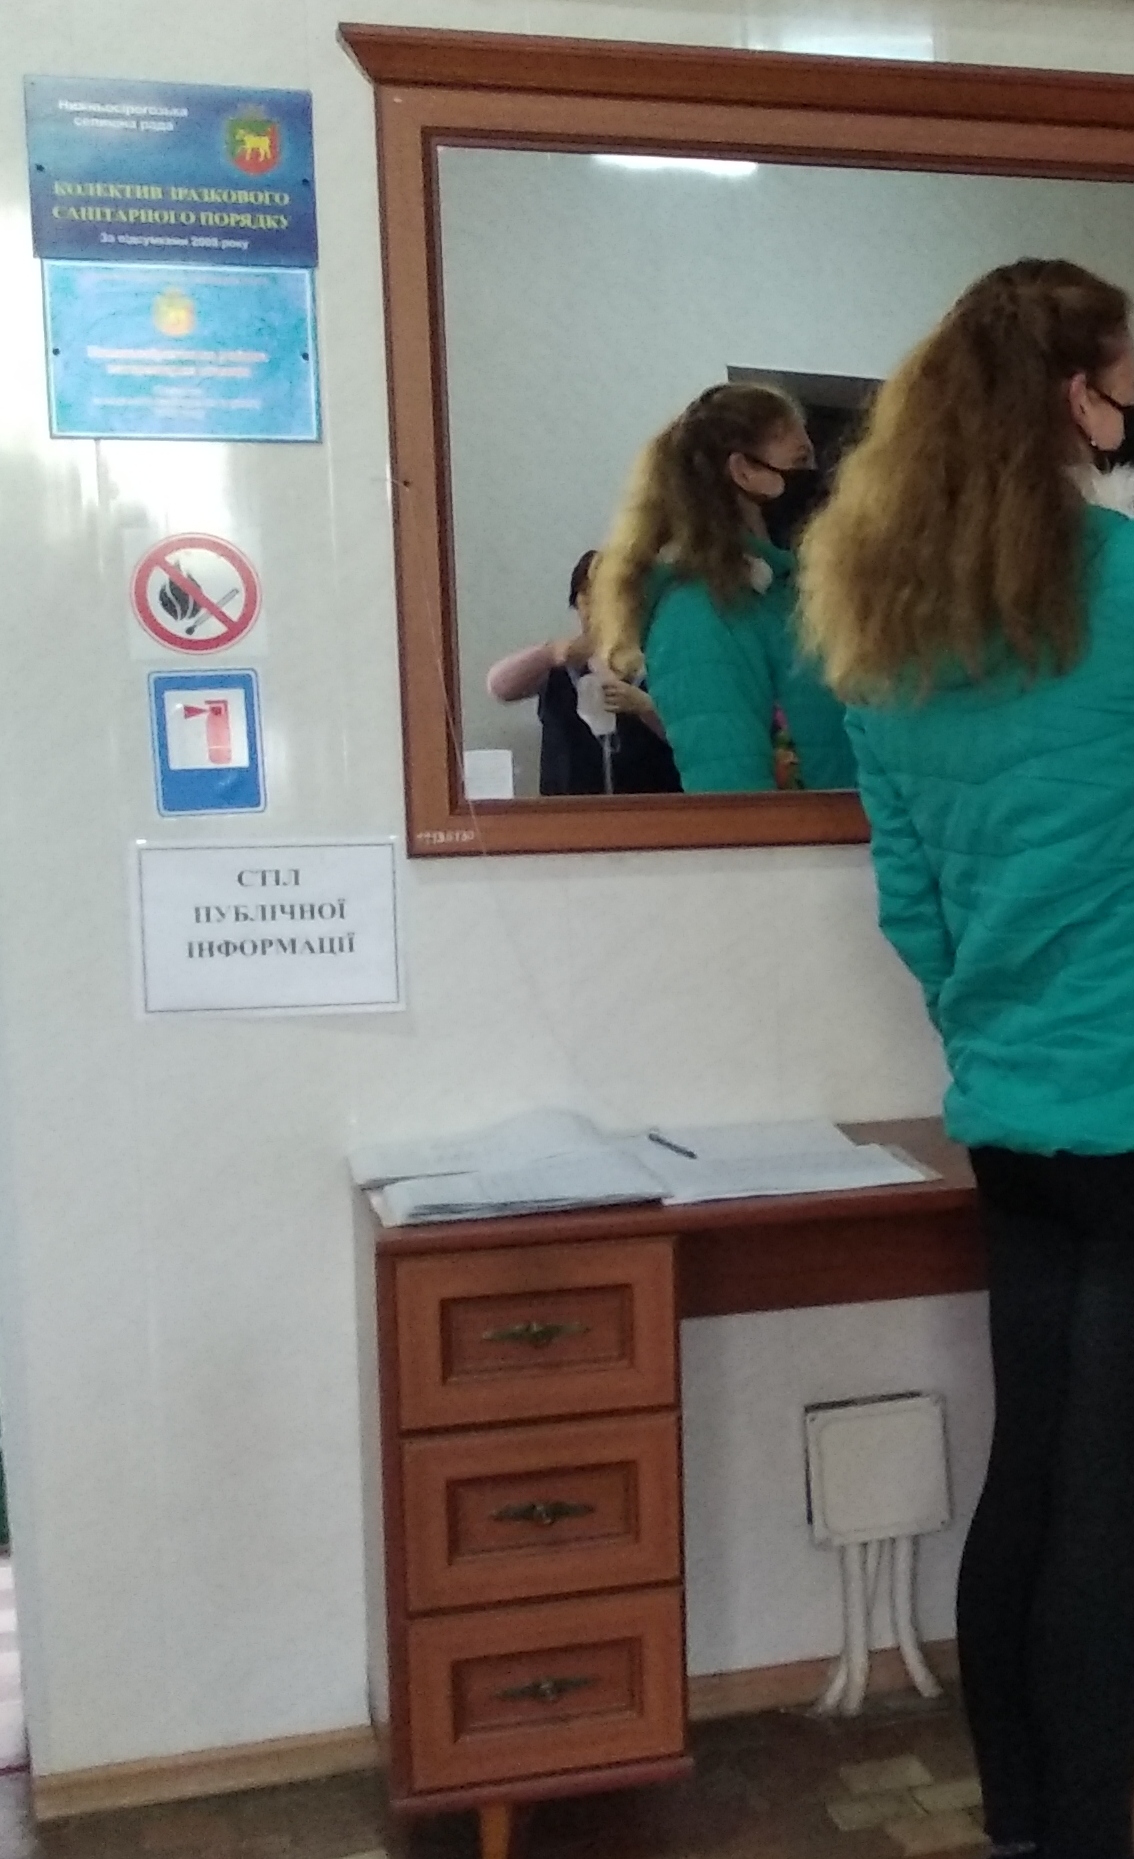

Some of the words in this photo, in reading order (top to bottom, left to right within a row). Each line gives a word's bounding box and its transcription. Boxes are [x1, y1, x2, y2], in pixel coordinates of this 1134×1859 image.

[54, 181, 163, 200] КОЛЕКТИВ
[52, 206, 196, 226] САНІТАРНОГО
[200, 211, 289, 230] ПОРЯДКУ
[237, 868, 301, 888] СТІЛ
[194, 898, 346, 924] ПУБЛІЧНОЇ
[187, 932, 355, 958] ІНФОРМАЦІЇ
